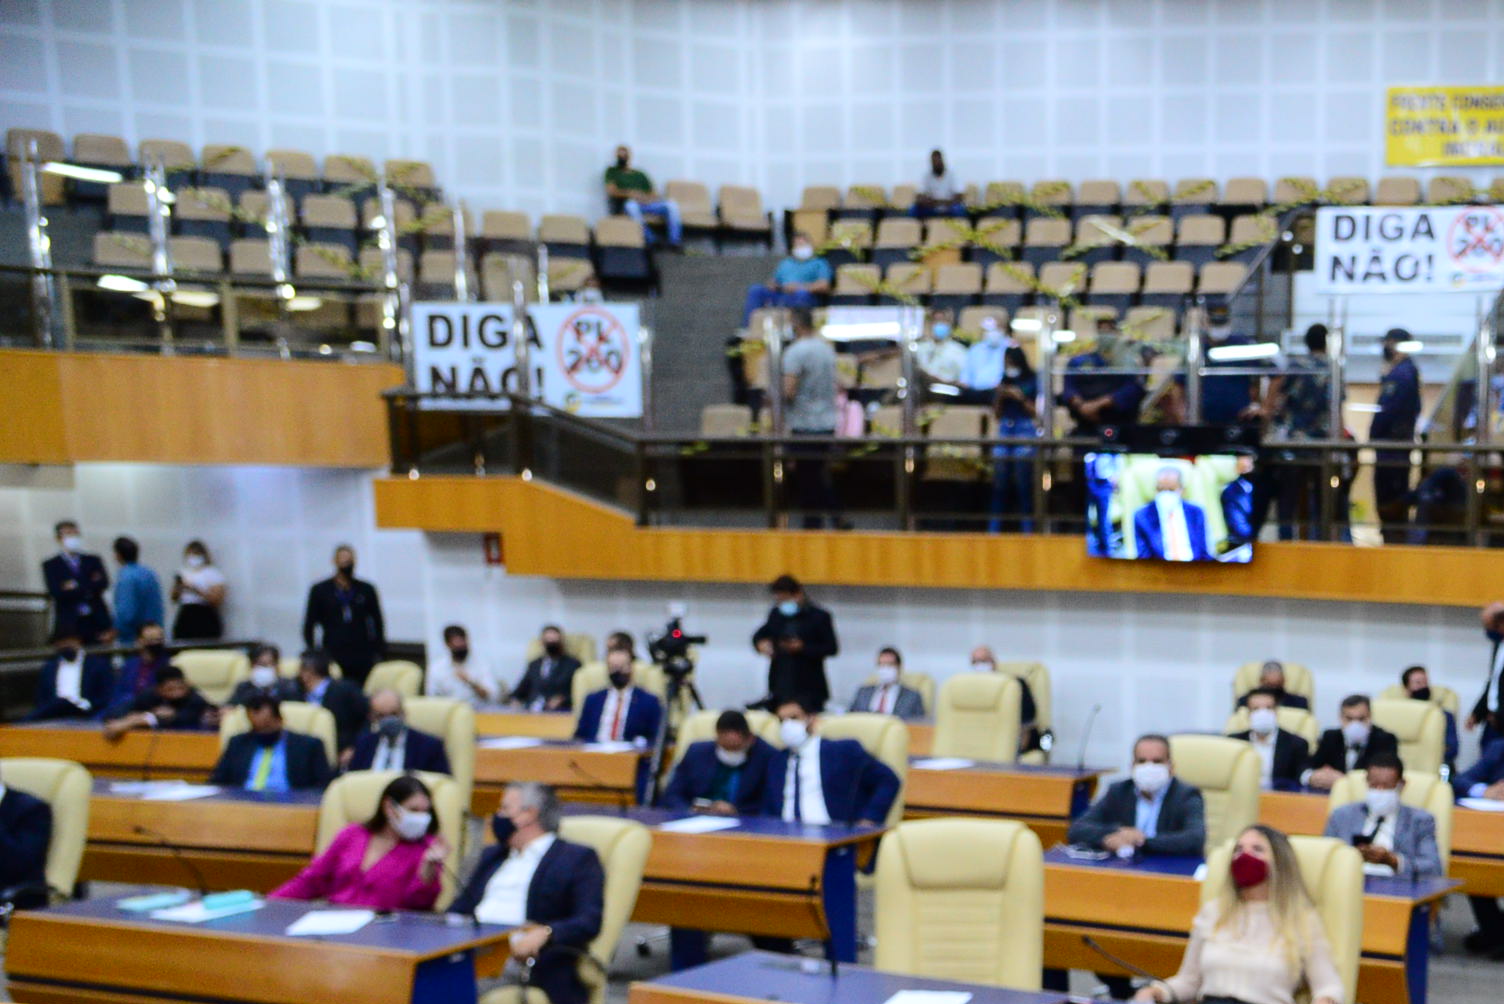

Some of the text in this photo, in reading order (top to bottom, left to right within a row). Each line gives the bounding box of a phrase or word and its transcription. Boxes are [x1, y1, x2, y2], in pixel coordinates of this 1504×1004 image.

[1334, 213, 1435, 242] DIGA
[1330, 249, 1434, 283] NÃO!
[428, 314, 543, 349] DIGA
[575, 321, 610, 343] PL
